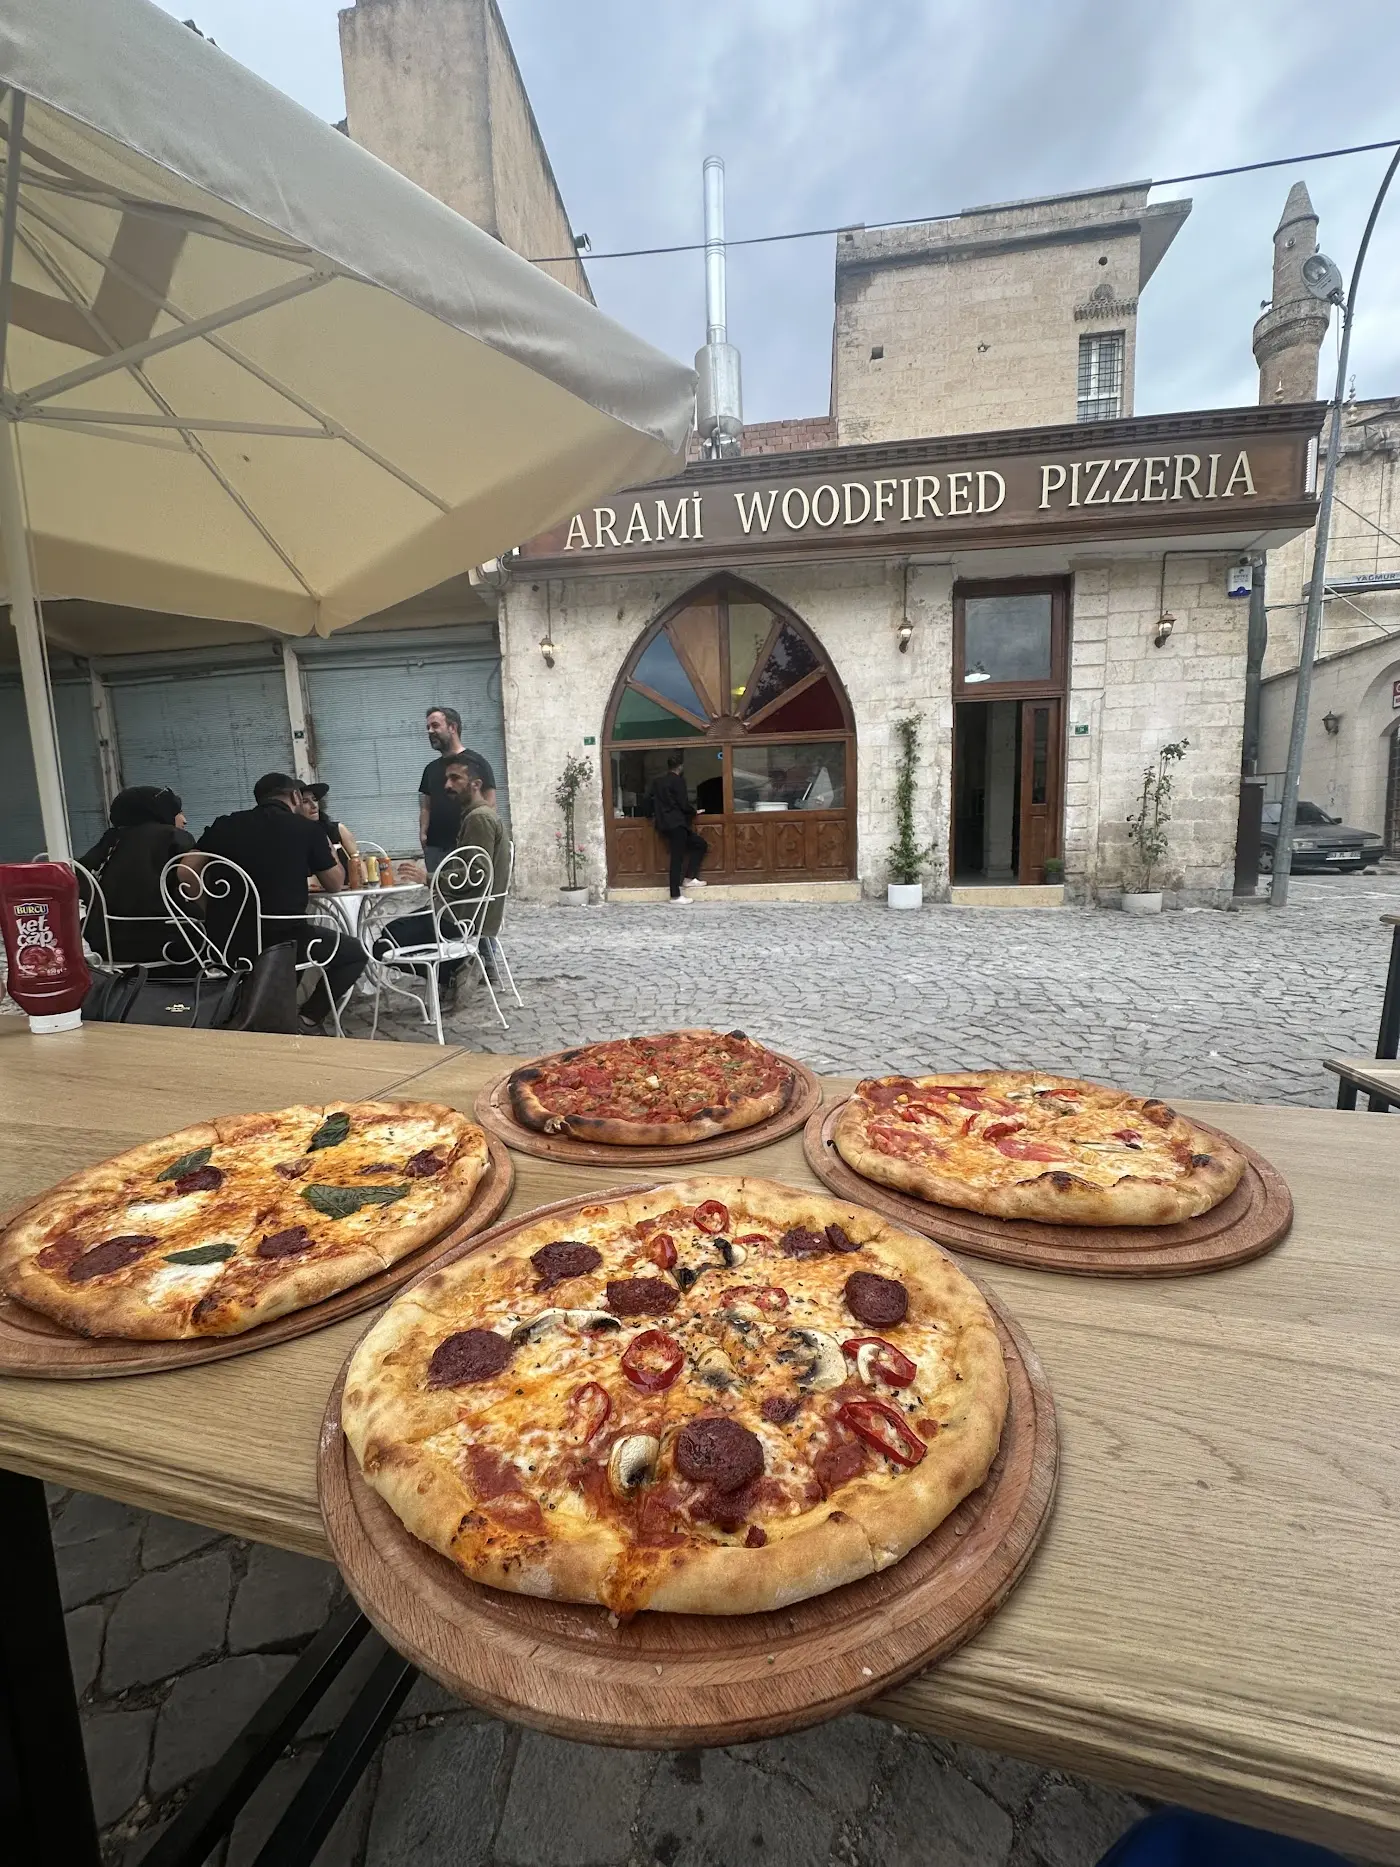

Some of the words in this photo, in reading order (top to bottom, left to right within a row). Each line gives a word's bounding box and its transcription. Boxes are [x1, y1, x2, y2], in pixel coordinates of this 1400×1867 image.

[563, 490, 704, 550] ARAMİ
[733, 470, 1006, 533] WOODFIRED
[1039, 450, 1258, 509] PIZZERIA
[16, 905, 46, 915] BURCU
[16, 915, 50, 935] ket
